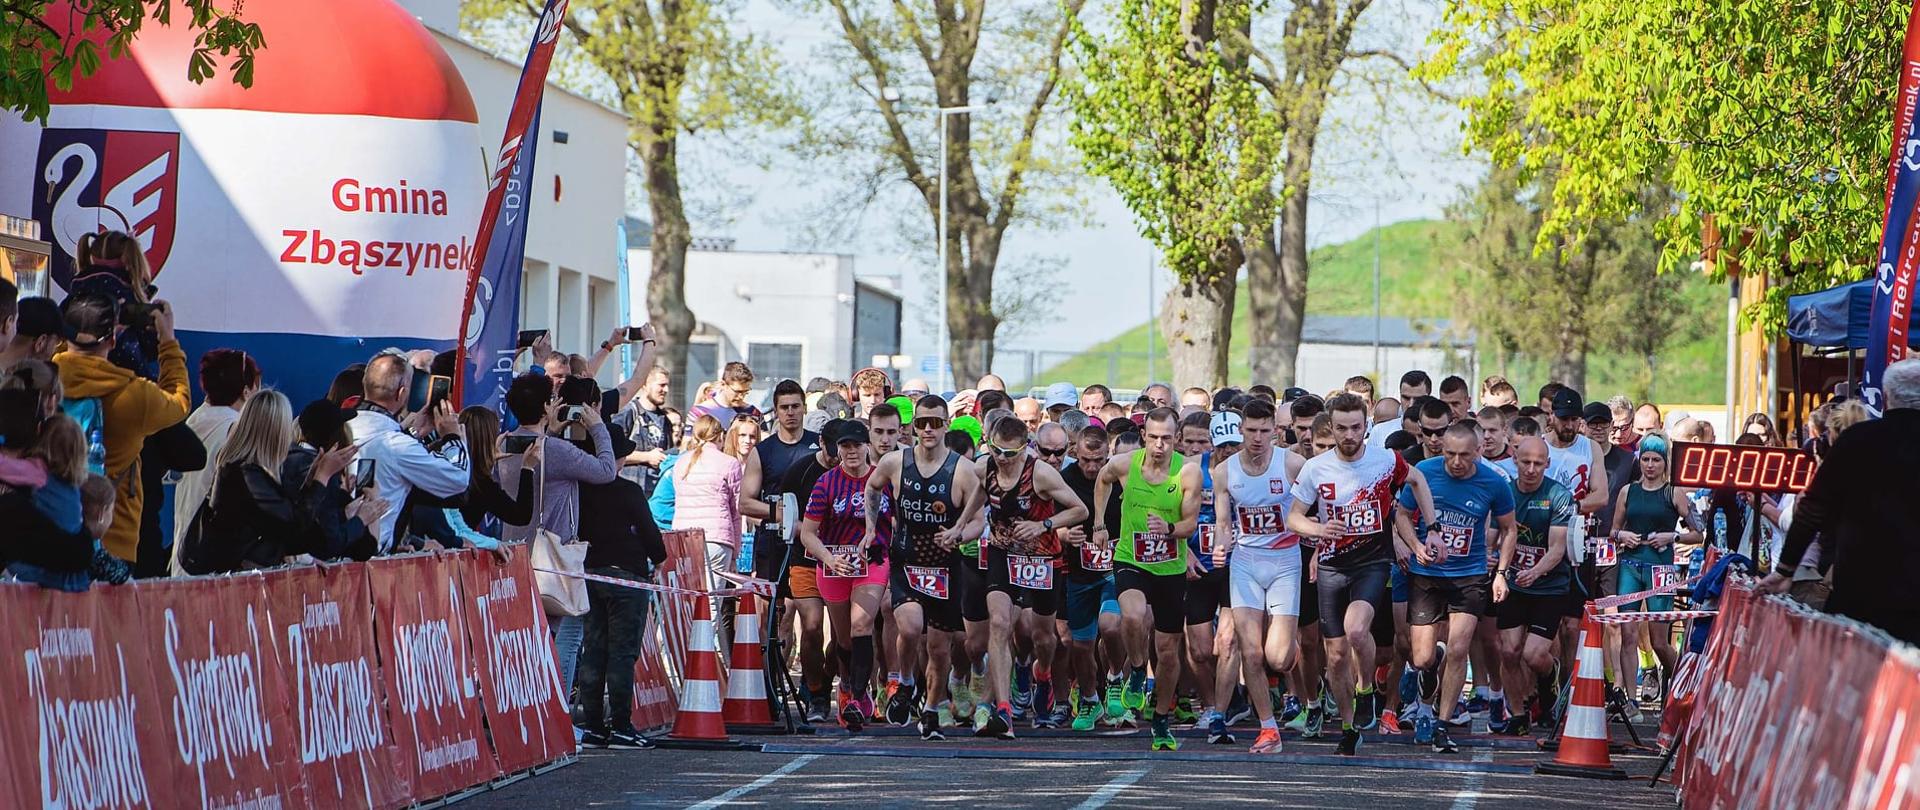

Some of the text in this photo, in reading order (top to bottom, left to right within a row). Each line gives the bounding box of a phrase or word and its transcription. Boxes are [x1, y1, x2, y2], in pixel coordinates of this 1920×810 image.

[332, 178, 448, 216] Gmina
[280, 229, 472, 276] Zbąszynek
[1246, 513, 1277, 529] 112
[1341, 509, 1376, 529] 168
[1143, 540, 1168, 556] 34
[1439, 532, 1466, 549] 36
[1090, 549, 1113, 564] 79
[1515, 550, 1536, 567] 73
[1014, 564, 1048, 582] 109
[916, 575, 937, 590] 12
[450, 575, 476, 699] 2
